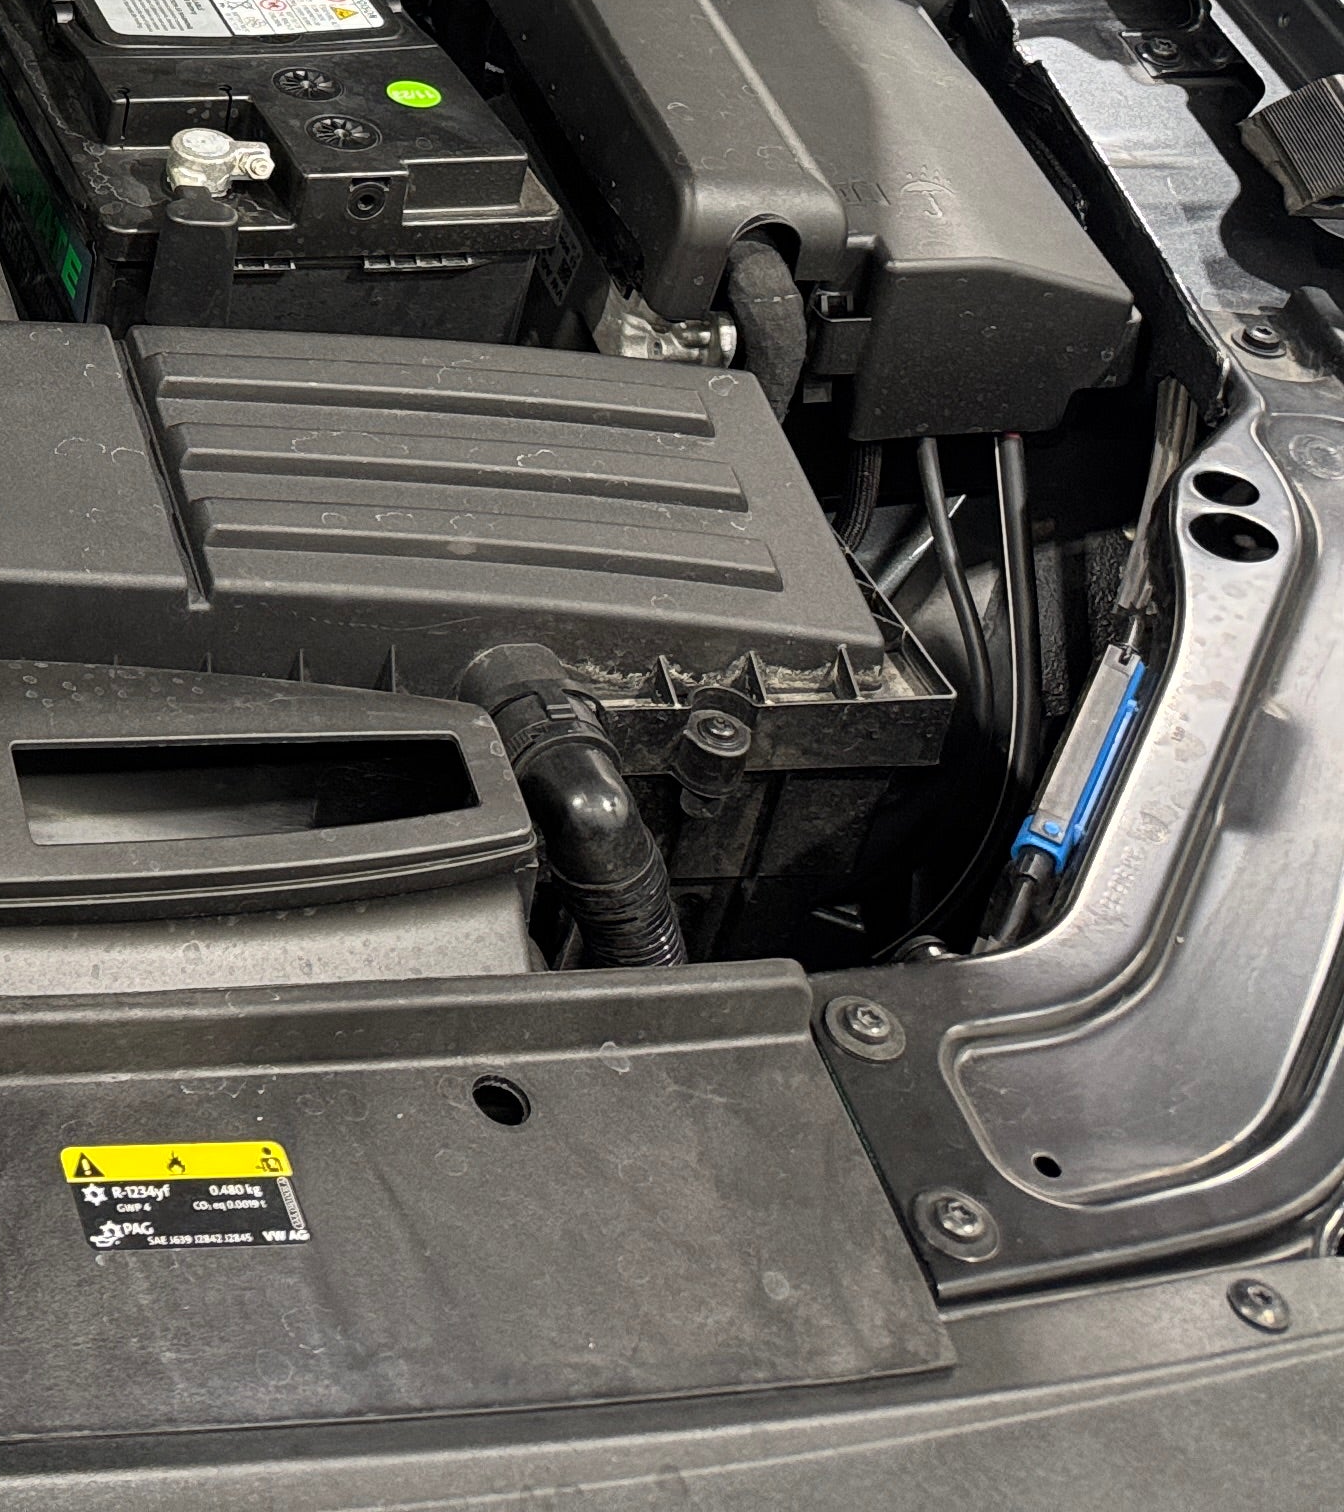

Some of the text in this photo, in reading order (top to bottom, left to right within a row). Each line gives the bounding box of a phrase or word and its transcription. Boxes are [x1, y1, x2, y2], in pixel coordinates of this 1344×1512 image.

[111, 1183, 171, 1202] R-1234yf
[208, 1183, 264, 1198] 0.480 kg
[121, 1221, 155, 1236] PAG
[262, 1230, 310, 1242] VW AG
